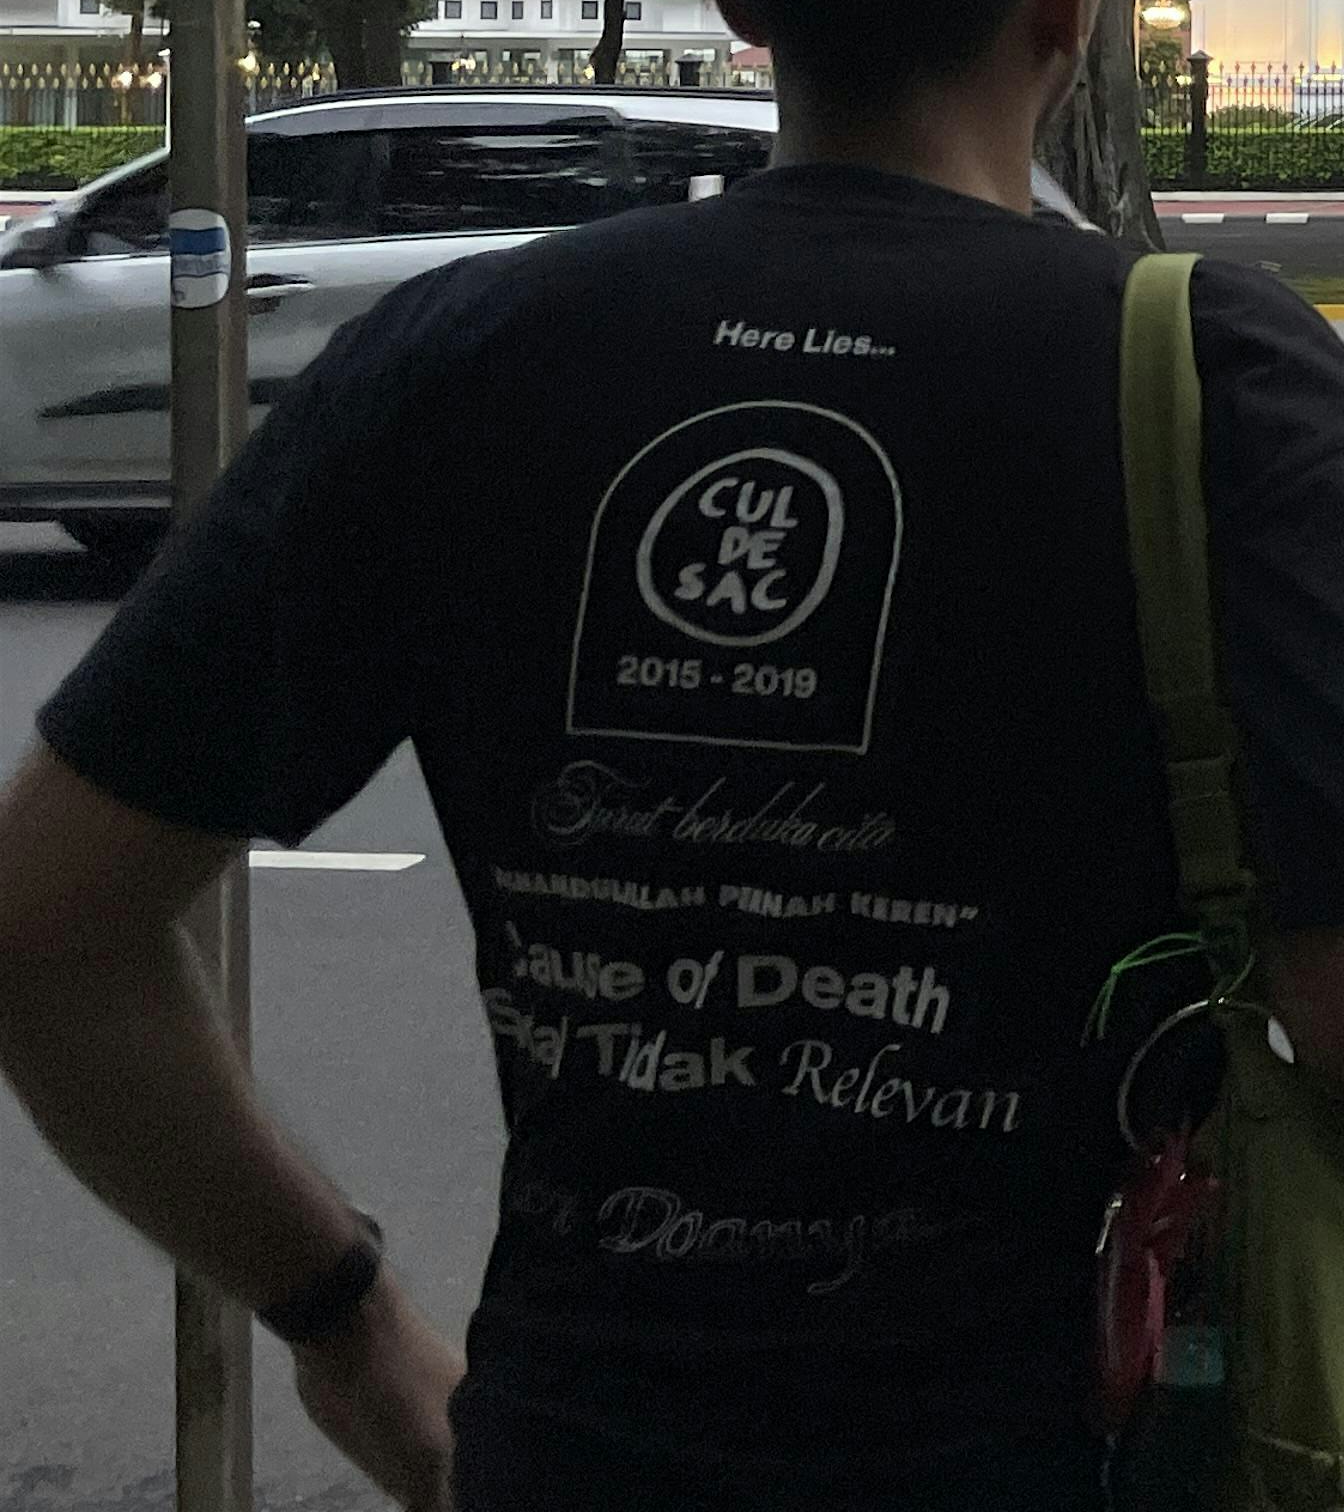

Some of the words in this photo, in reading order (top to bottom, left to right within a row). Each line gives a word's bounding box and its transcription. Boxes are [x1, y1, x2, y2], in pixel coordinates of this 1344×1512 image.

[712, 319, 795, 352] Here
[802, 327, 897, 357] Lies...
[697, 476, 800, 530] CUL
[716, 524, 788, 571] DE
[673, 562, 788, 616] SAC
[616, 653, 703, 691] 2015
[729, 661, 819, 700] 2019
[736, 952, 951, 1035] Death
[575, 1020, 758, 1093] Tidak
[779, 1038, 1023, 1134] Relevan
